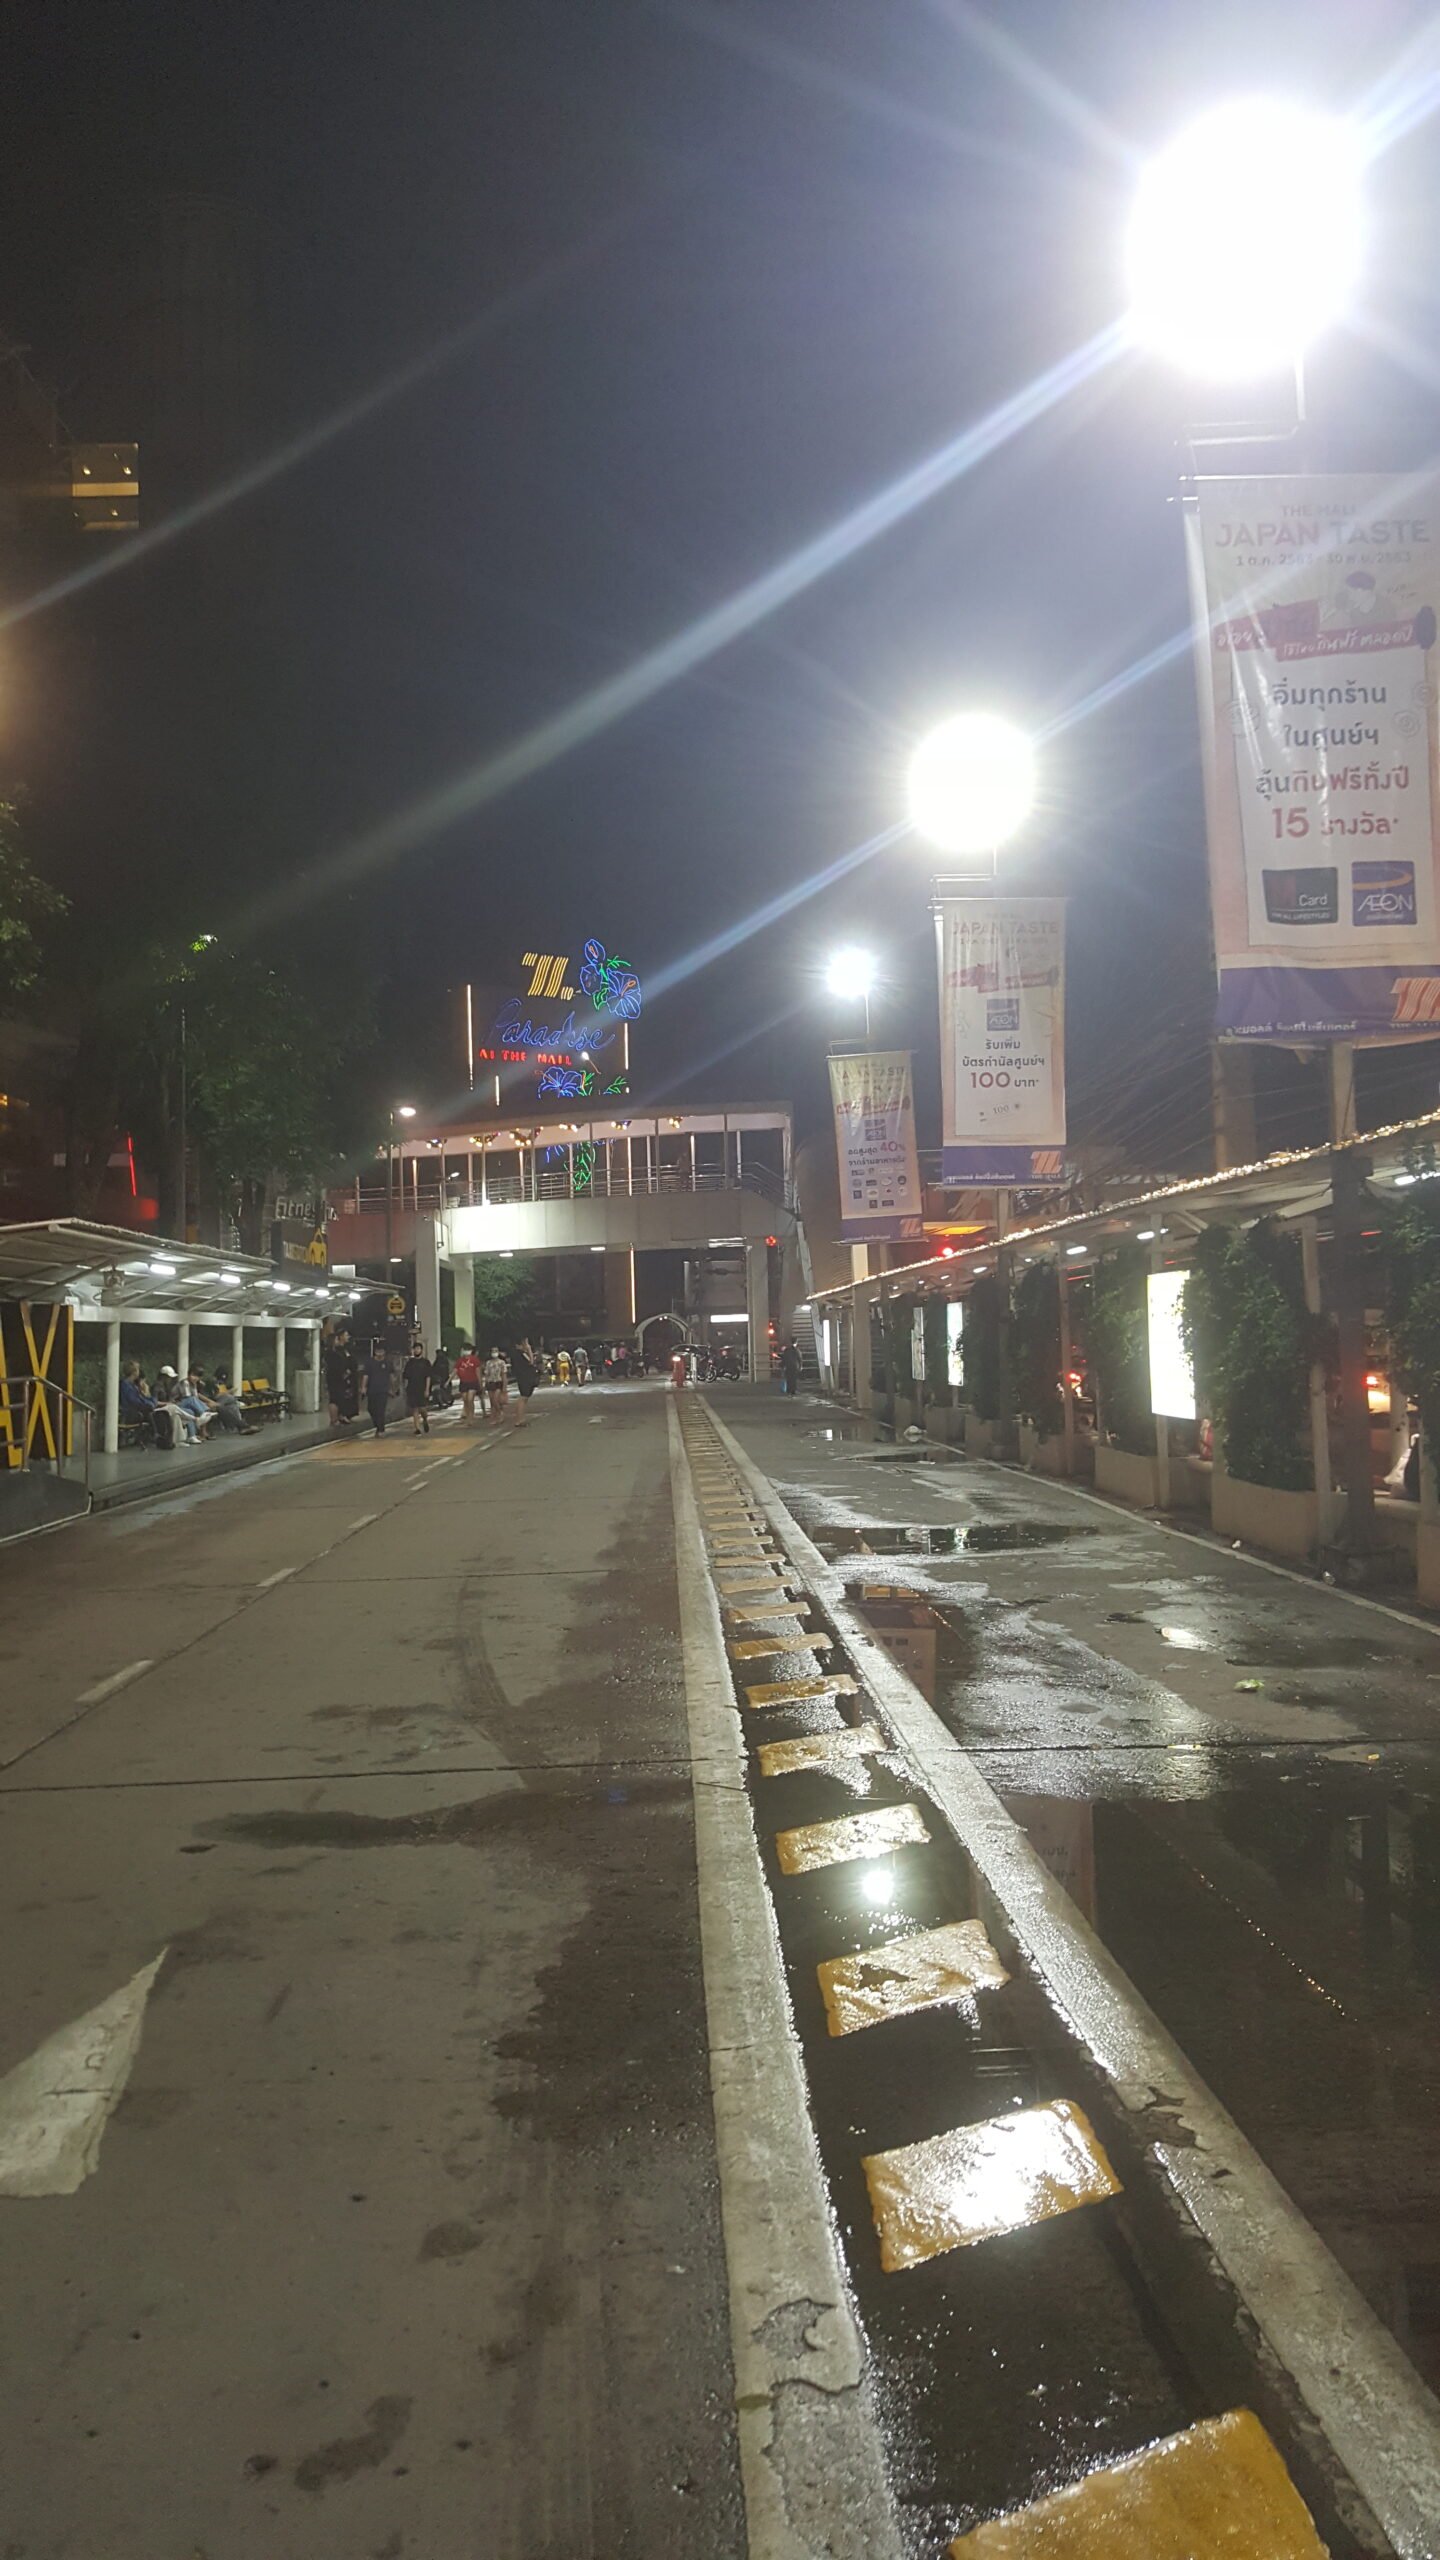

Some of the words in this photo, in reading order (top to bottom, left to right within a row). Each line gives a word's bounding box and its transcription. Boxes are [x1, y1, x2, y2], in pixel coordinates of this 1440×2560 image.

[1215, 522, 1321, 548] JAPAN
[1333, 519, 1431, 545] TASTE
[1273, 677, 1387, 712] อิ่มทุกร้าน
[1284, 721, 1379, 752] ในศูนย์ฯ
[1256, 761, 1410, 801] ลุ้นกินฟรีทั้งปี
[1272, 807, 1310, 839] 15
[1299, 893, 1328, 907] Card
[1009, 921, 1059, 935] TASTE
[985, 1036, 1021, 1050] รับเพิ่ม
[502, 1050, 527, 1062] THE
[970, 1071, 1011, 1088] 100
[993, 1104, 1009, 1115] 100
